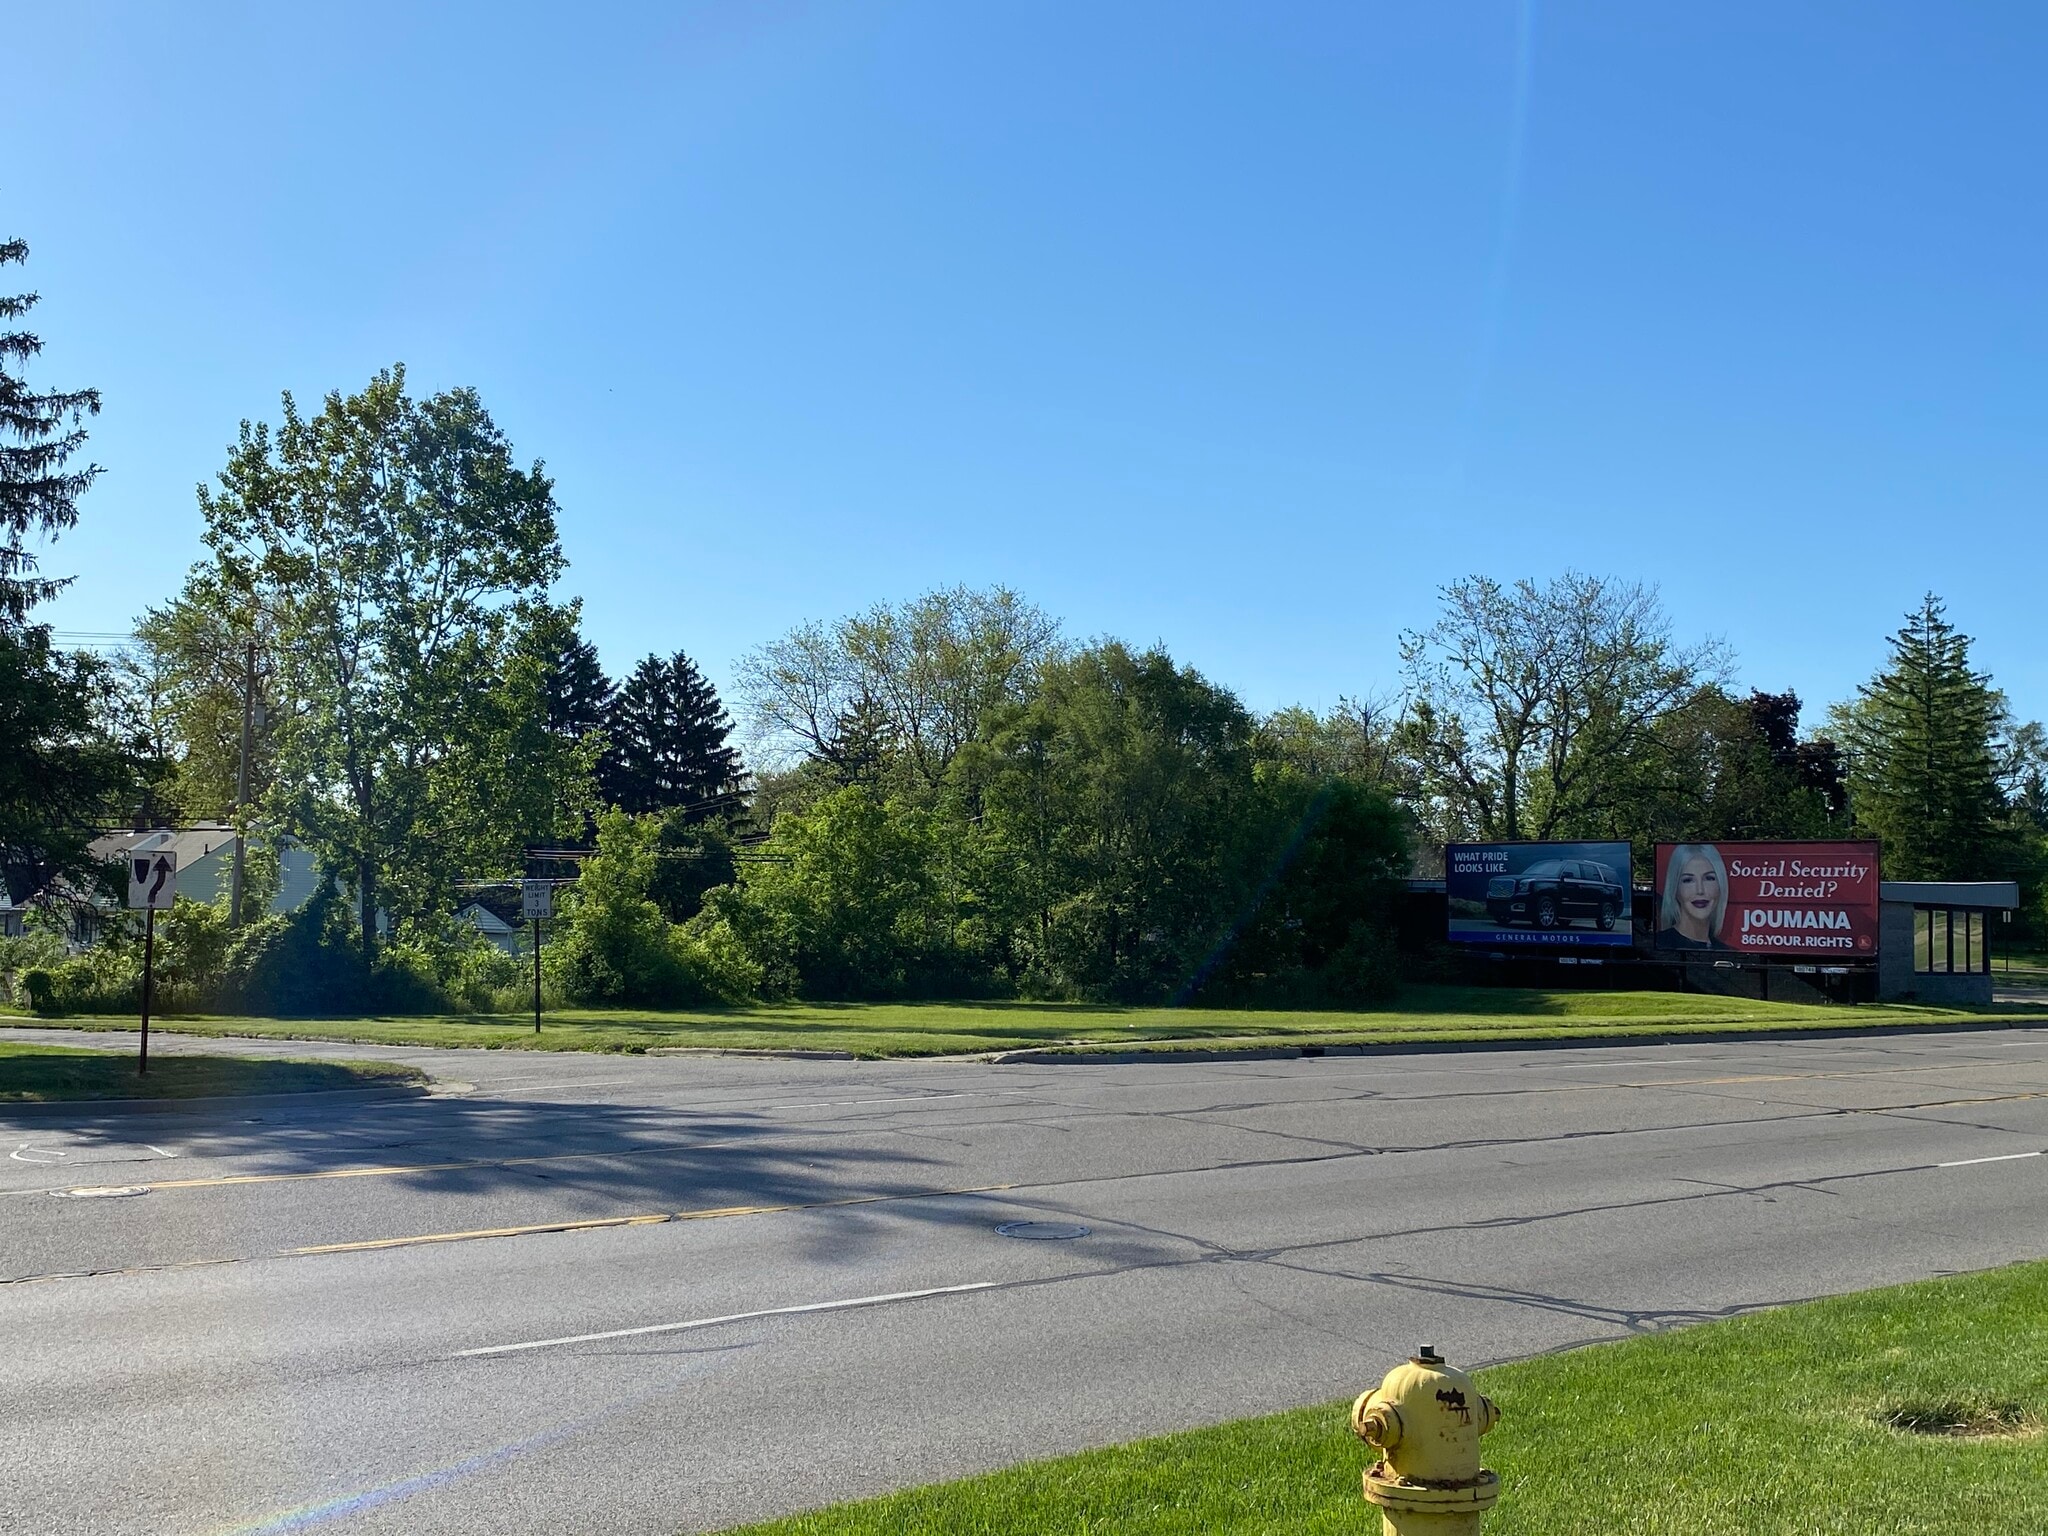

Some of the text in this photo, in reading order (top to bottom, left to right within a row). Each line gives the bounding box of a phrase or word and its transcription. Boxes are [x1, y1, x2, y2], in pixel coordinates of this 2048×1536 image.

[1454, 851, 1509, 862] WHAT PRIDE
[1454, 863, 1507, 873] LOOKS LIKE.
[1730, 860, 1869, 884] Social Security
[1758, 880, 1838, 898] Denied?
[1741, 909, 1852, 932] JOUMANA
[1495, 933, 1580, 943] GENERAL MOTORS
[1741, 934, 1853, 948] 866.YOUR.RIGHTS
